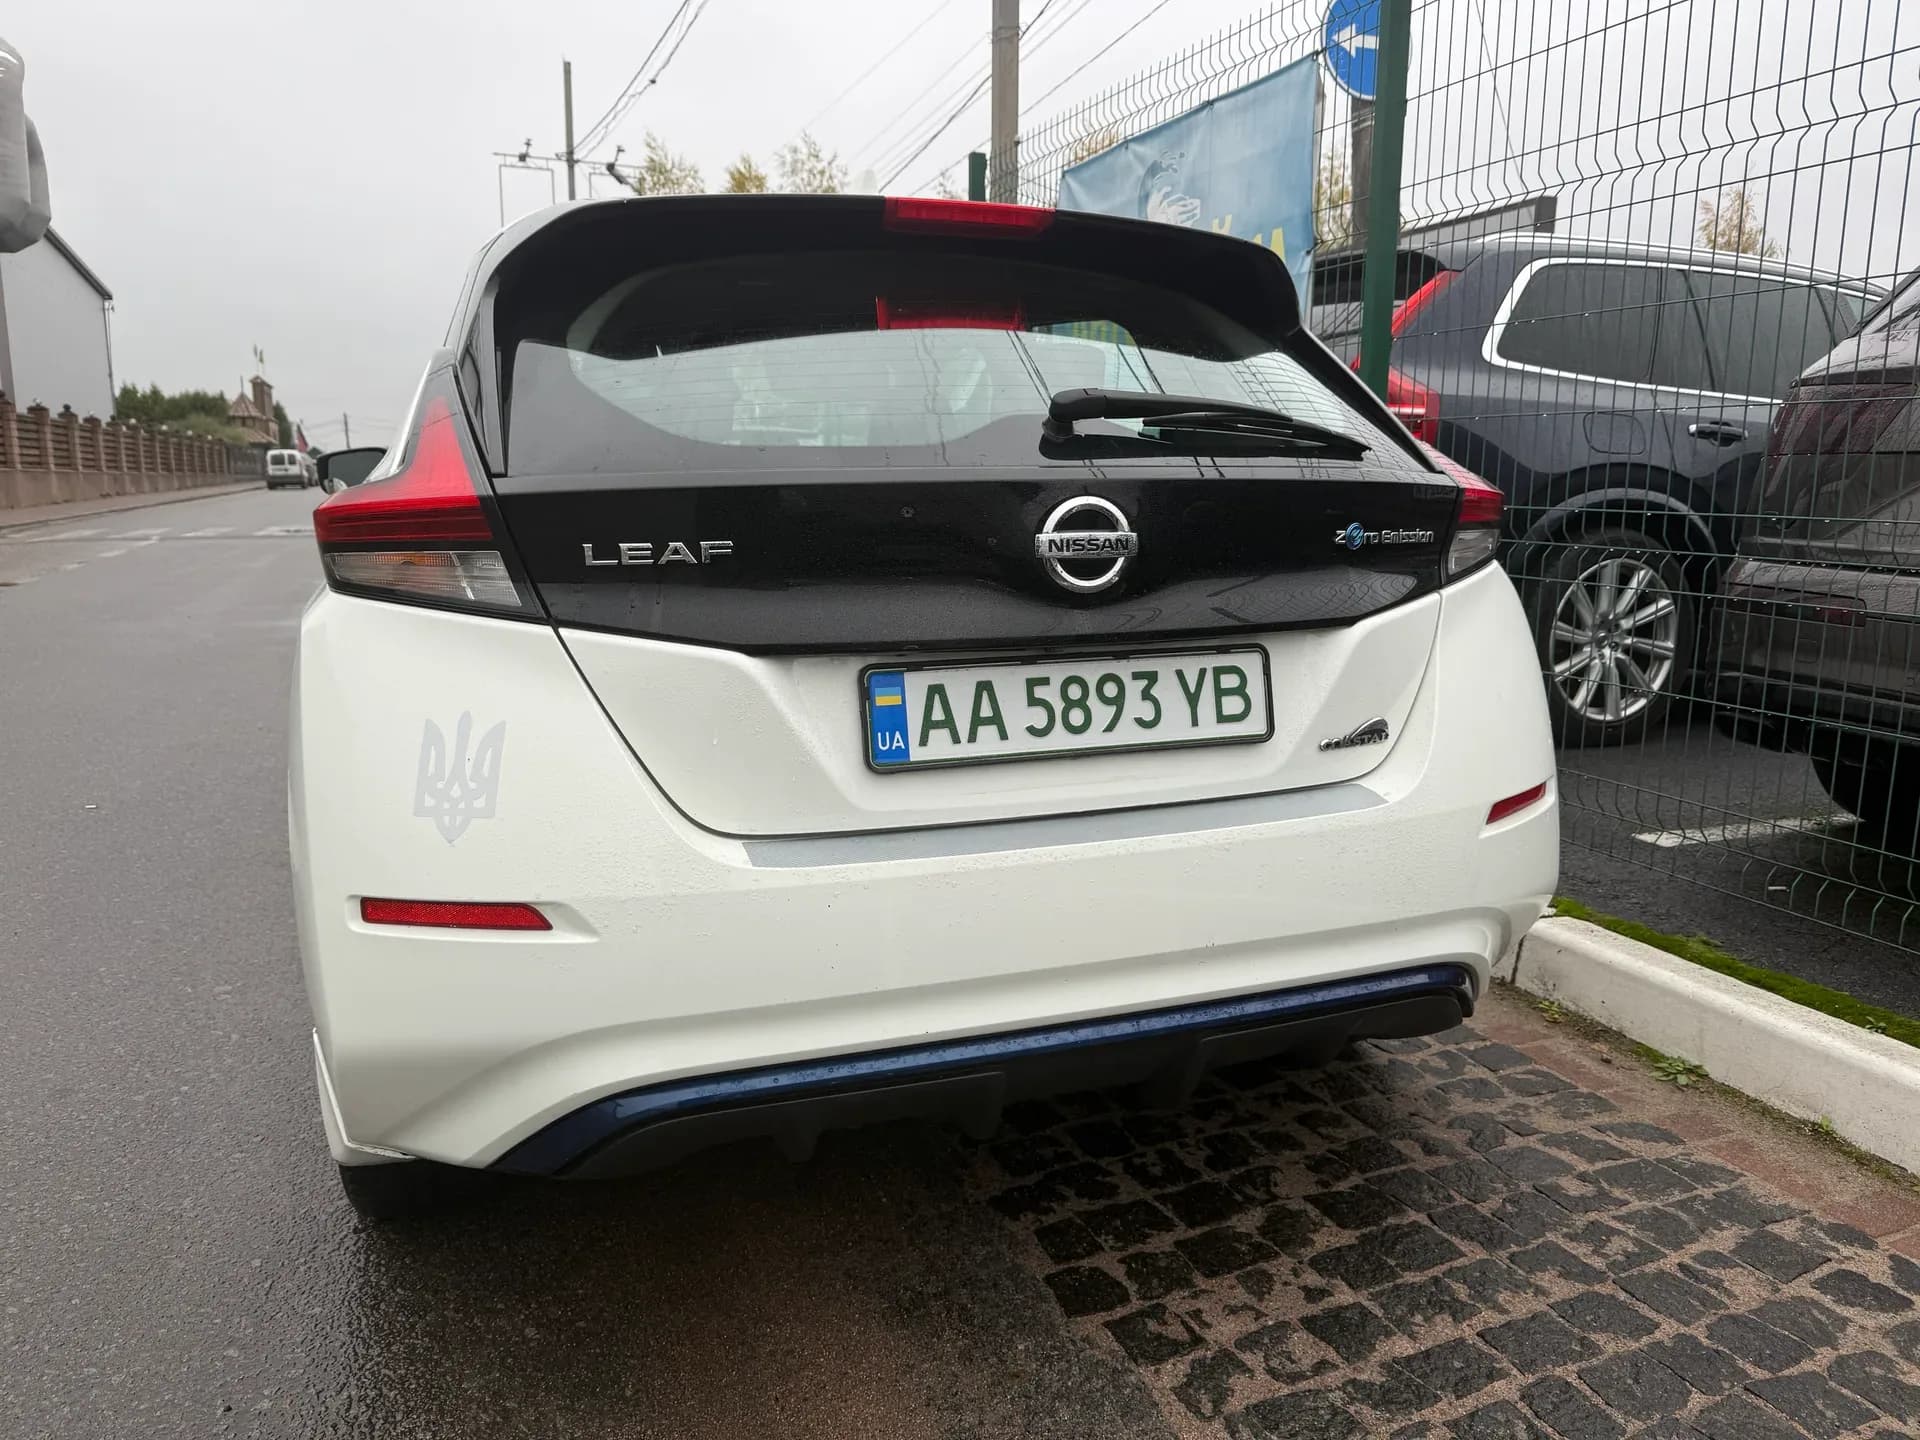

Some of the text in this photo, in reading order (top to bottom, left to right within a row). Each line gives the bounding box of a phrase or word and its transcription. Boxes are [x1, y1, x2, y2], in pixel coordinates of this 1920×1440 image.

[1048, 537, 1129, 553] NISSAN
[1335, 522, 1434, 550] Zero Emission
[582, 540, 734, 566] LEAF
[918, 665, 1252, 747] AA 5893 YB
[877, 731, 905, 751] UA
